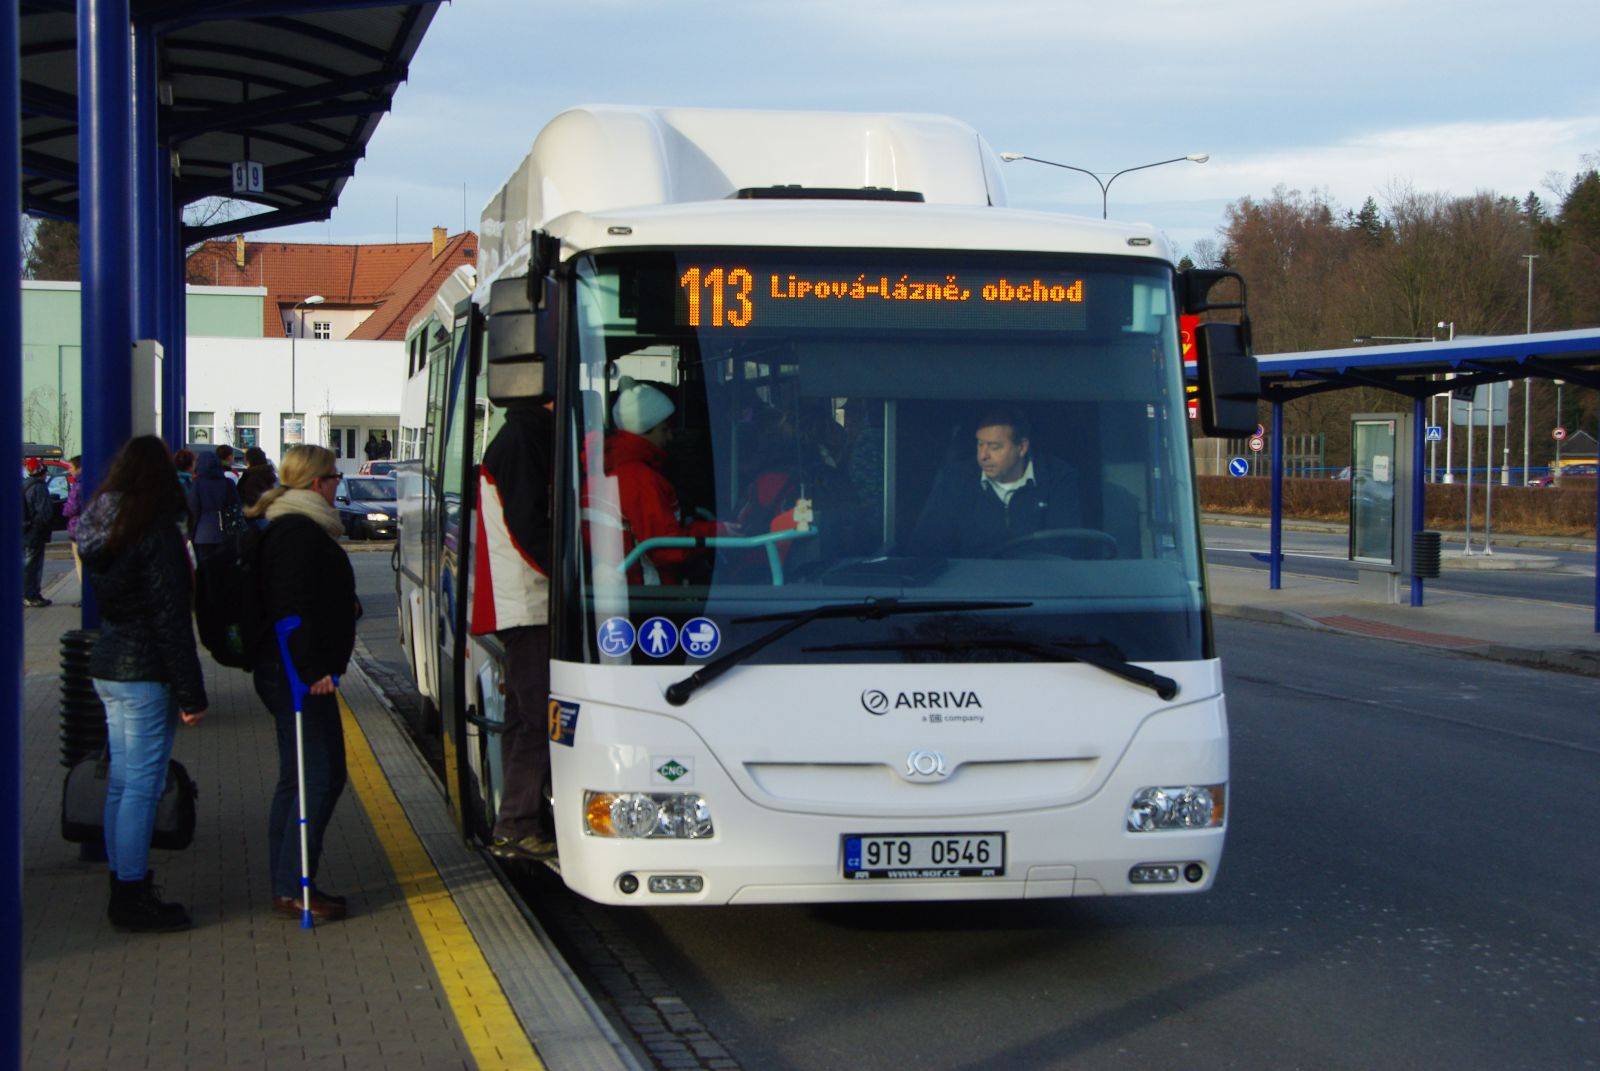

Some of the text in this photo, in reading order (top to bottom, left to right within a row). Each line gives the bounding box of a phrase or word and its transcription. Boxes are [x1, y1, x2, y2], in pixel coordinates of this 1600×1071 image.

[236, 166, 243, 187] 9
[252, 166, 259, 187] 9
[680, 267, 1084, 328] 113 Lipová-lázně, obchod
[894, 691, 983, 710] ARRIVA
[944, 715, 985, 724] company
[661, 765, 684, 777] CNG
[848, 857, 860, 867] CZ
[867, 839, 990, 866] 9T9 0546
[887, 869, 961, 879] www.sor.cz
